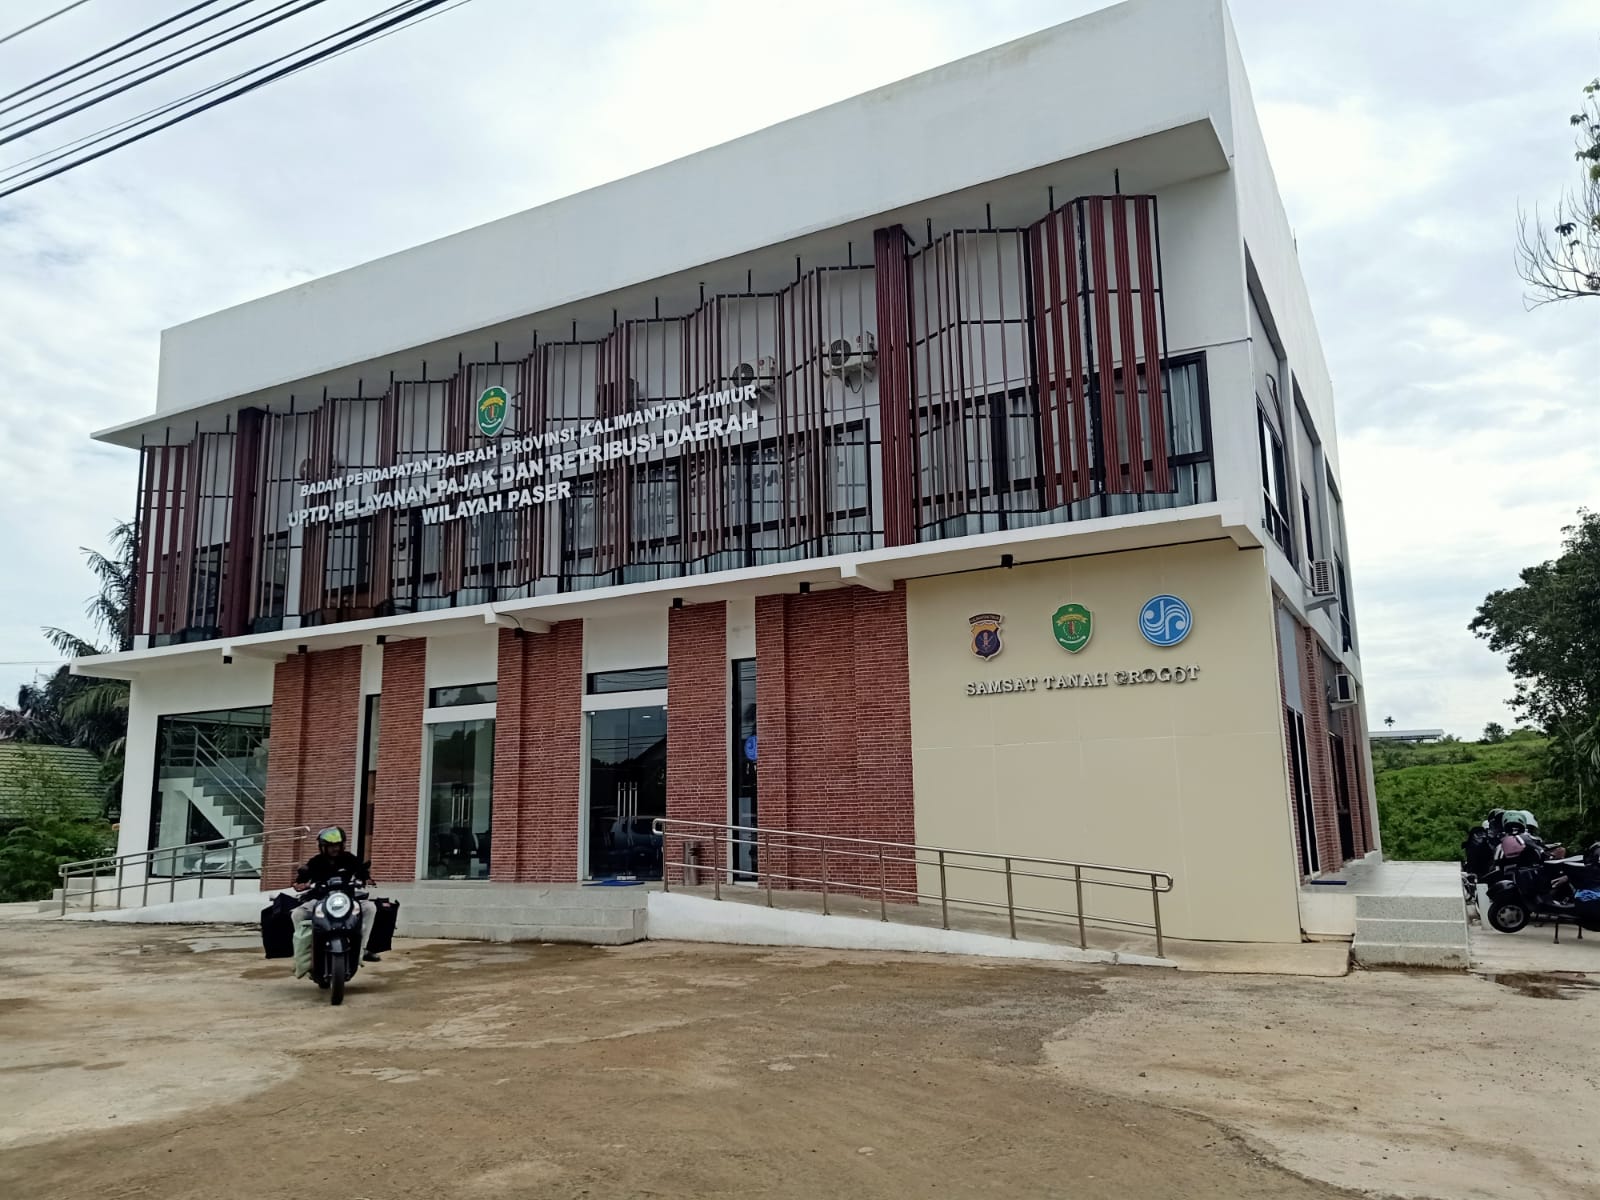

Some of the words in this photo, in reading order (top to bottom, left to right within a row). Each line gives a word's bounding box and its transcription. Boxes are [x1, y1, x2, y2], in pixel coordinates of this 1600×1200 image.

[300, 476, 343, 497] BADAN
[345, 458, 432, 487] PENDAPATAN
[436, 444, 497, 470] DAERAH
[502, 427, 576, 457] PROVINSI
[580, 399, 691, 438] KALIMANTAN
[697, 384, 757, 410] TIMUR
[334, 484, 431, 519] PELAYANAN
[437, 467, 496, 496] PAJAK
[502, 458, 543, 483] DAN
[550, 433, 656, 473] RETRIBUSI
[663, 409, 758, 449] DAERAH
[422, 494, 502, 525] WILAYAH
[507, 481, 571, 509] PASER
[967, 677, 1037, 695] SAMSAT
[1043, 672, 1108, 690] TANAH
[1114, 664, 1200, 685] GROGOT
